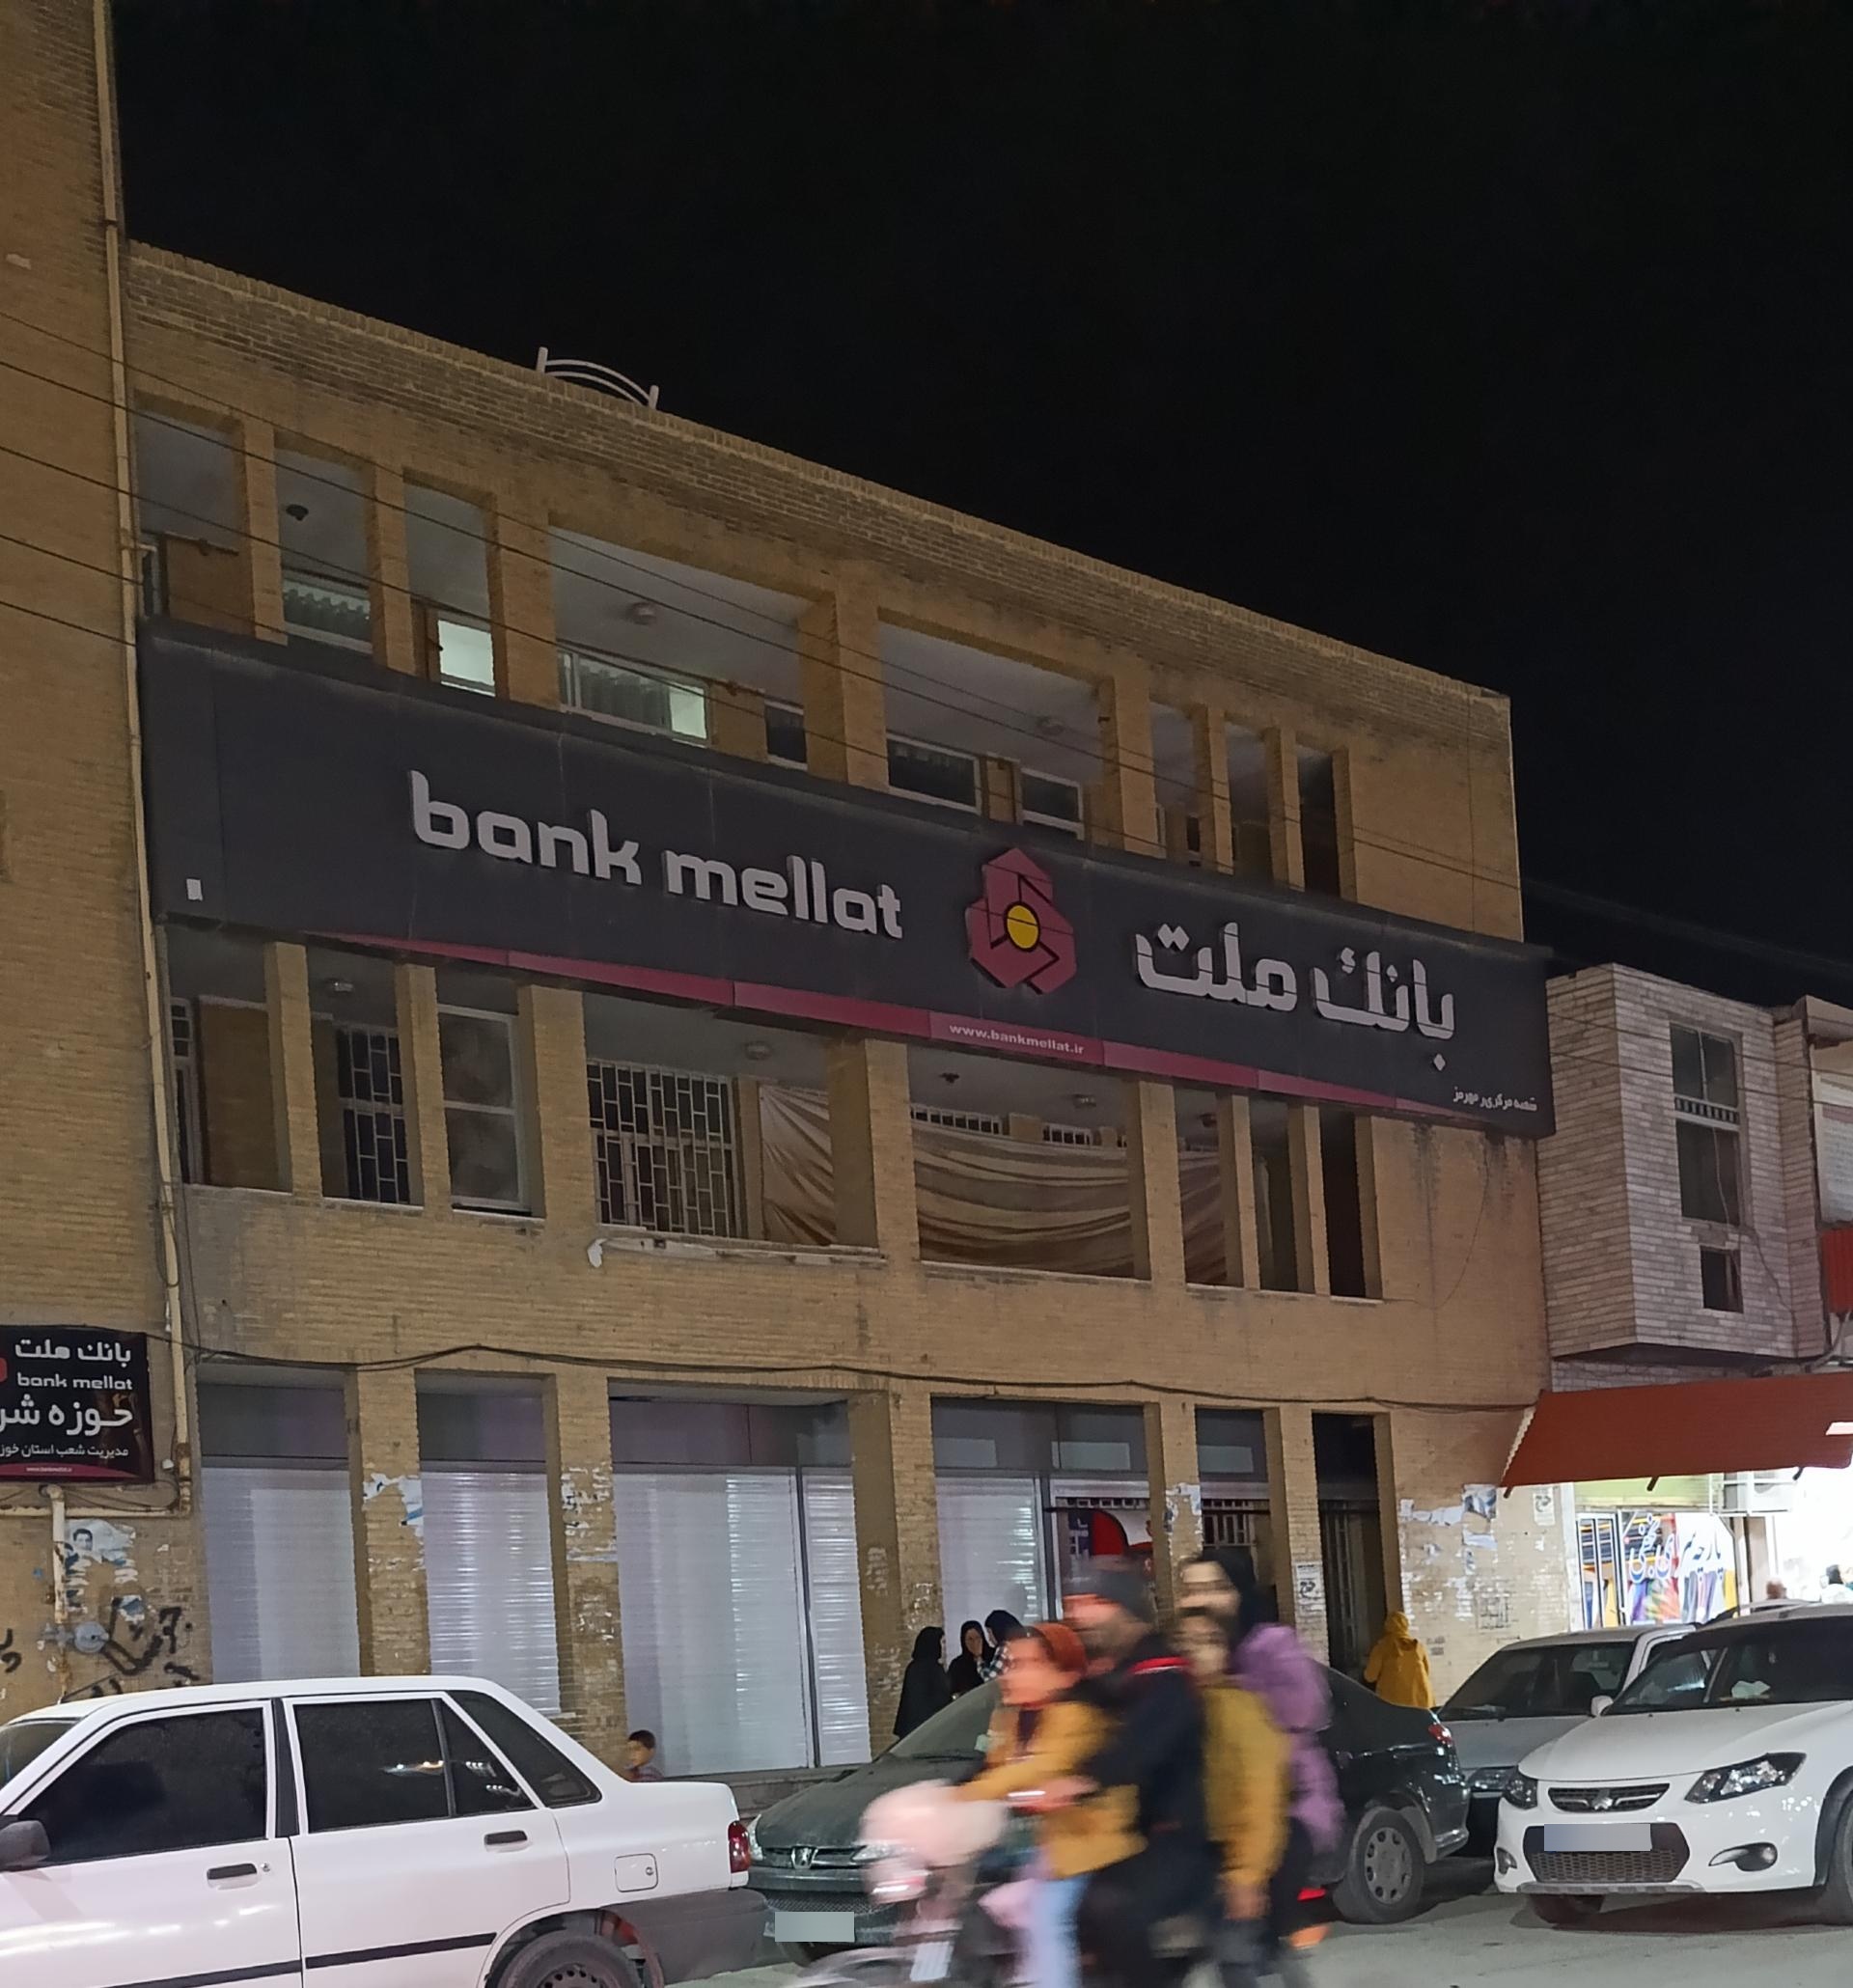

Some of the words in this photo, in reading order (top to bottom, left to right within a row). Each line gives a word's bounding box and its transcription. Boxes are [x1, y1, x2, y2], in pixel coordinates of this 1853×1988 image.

[409, 770, 642, 885] bank
[663, 849, 903, 939] mellat
[1135, 922, 1297, 1012] ملت
[949, 1024, 1085, 1055] www.bankmellat.ir
[14, 1339, 71, 1360] ملت
[17, 1371, 69, 1389] bank
[72, 1374, 133, 1391] mellat
[48, 1401, 134, 1436] حوزه
